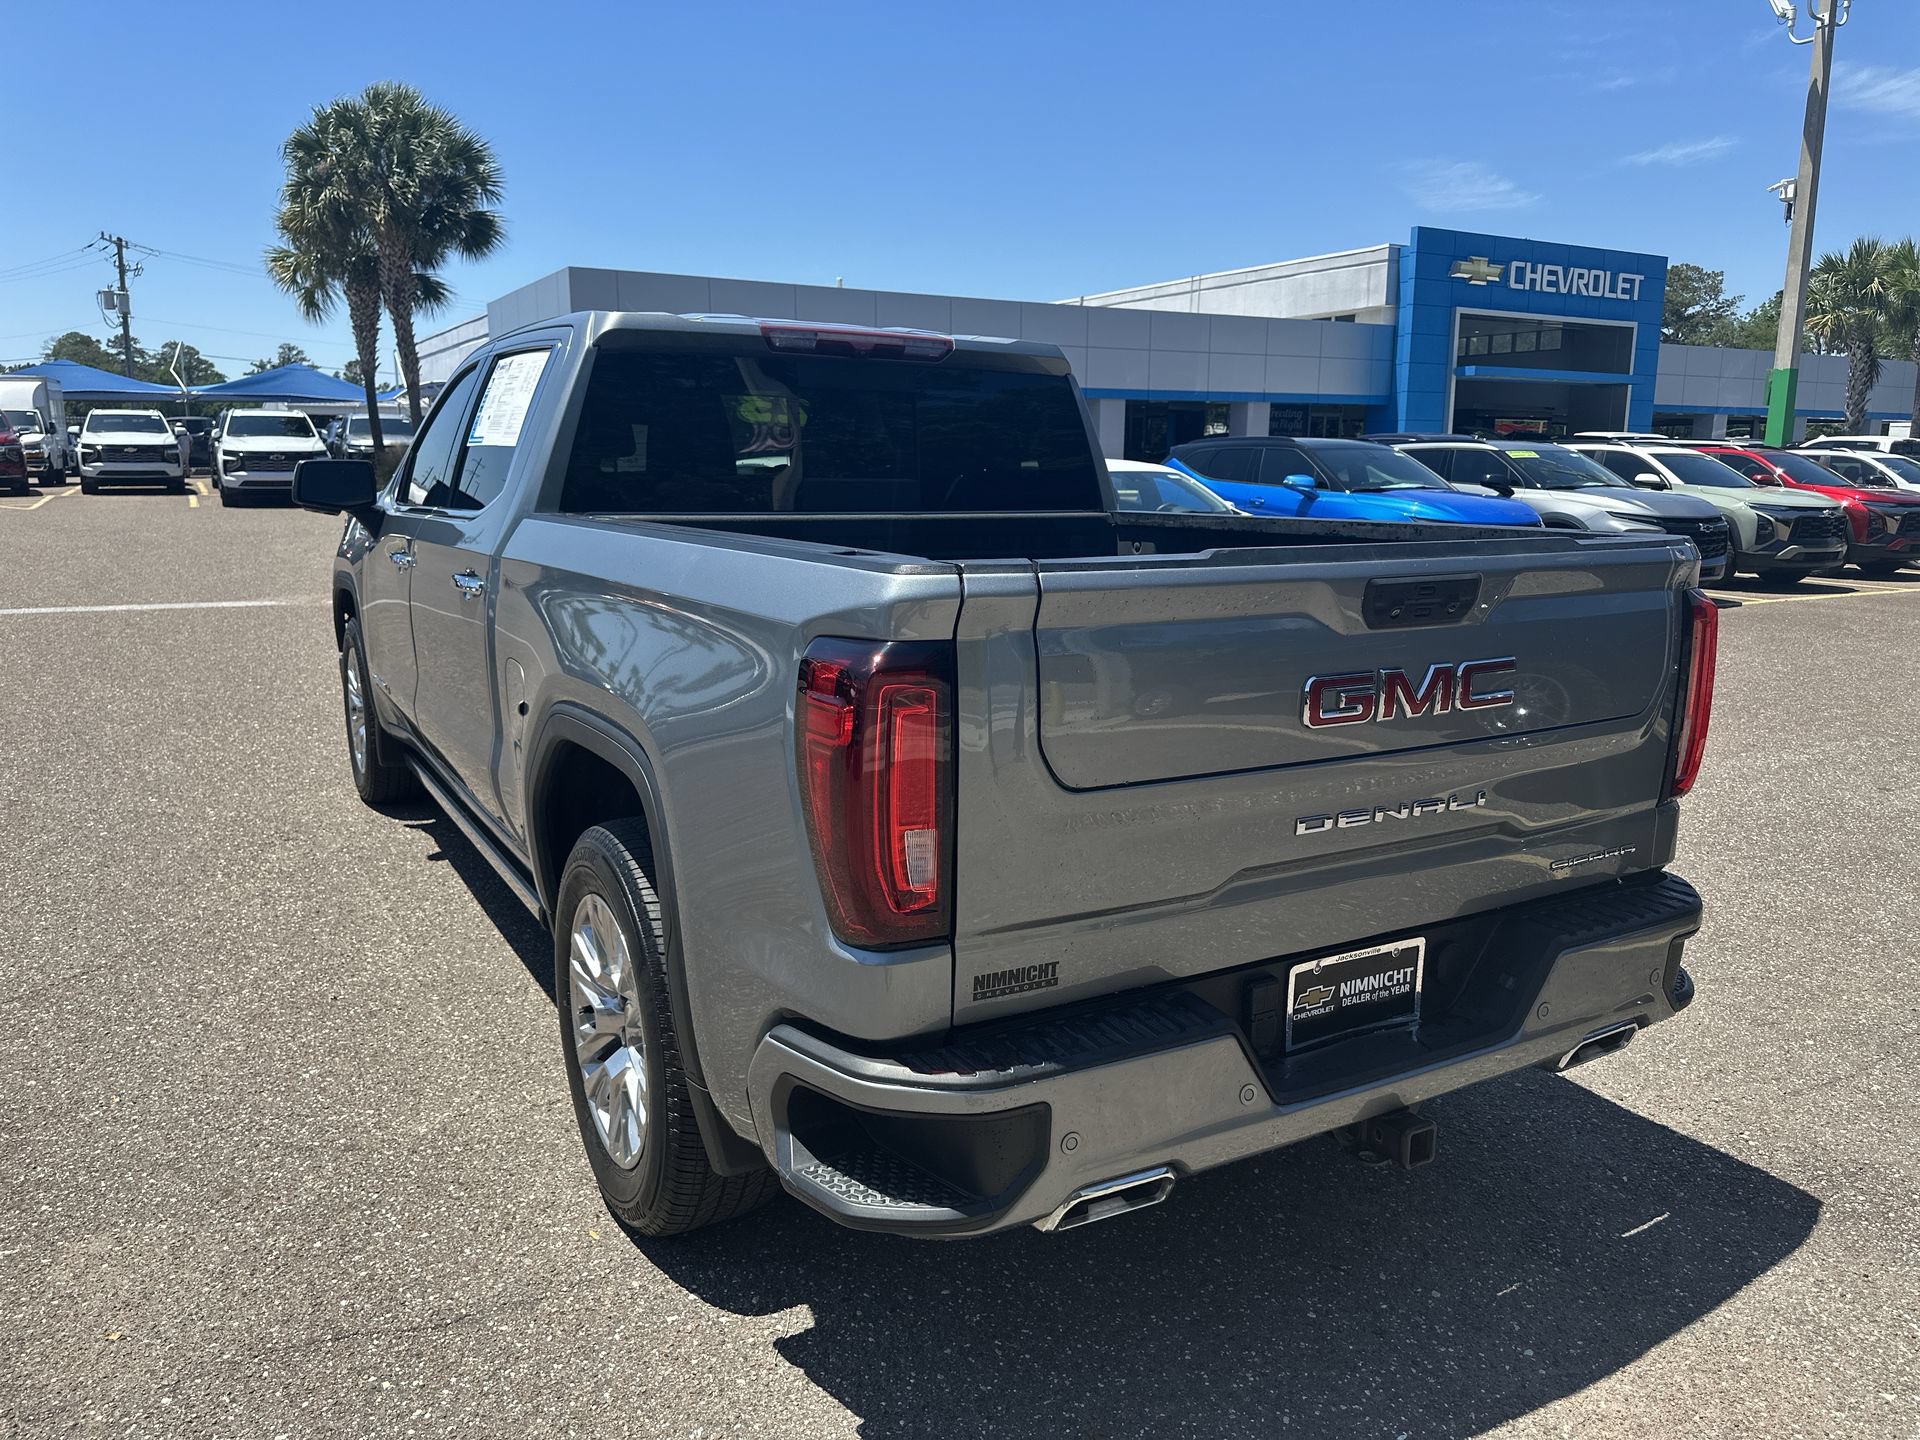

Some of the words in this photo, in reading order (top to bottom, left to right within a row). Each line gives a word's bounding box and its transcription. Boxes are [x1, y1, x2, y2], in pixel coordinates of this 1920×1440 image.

[1509, 261, 1644, 301] CHEVROLET
[1302, 655, 1517, 729] GMC
[1295, 790, 1487, 835] DENALI
[1335, 947, 1382, 962] Jacksonville
[973, 960, 1060, 992] NIMNICHT
[976, 980, 1056, 999] CHEVROLET
[1339, 967, 1414, 998] NIMNICHT
[1342, 993, 1370, 1007] DEALER
[1371, 991, 1380, 1002] of
[1379, 988, 1389, 999] the
[1390, 984, 1410, 996] YEAR
[1293, 1004, 1335, 1021] CHEVROLET
